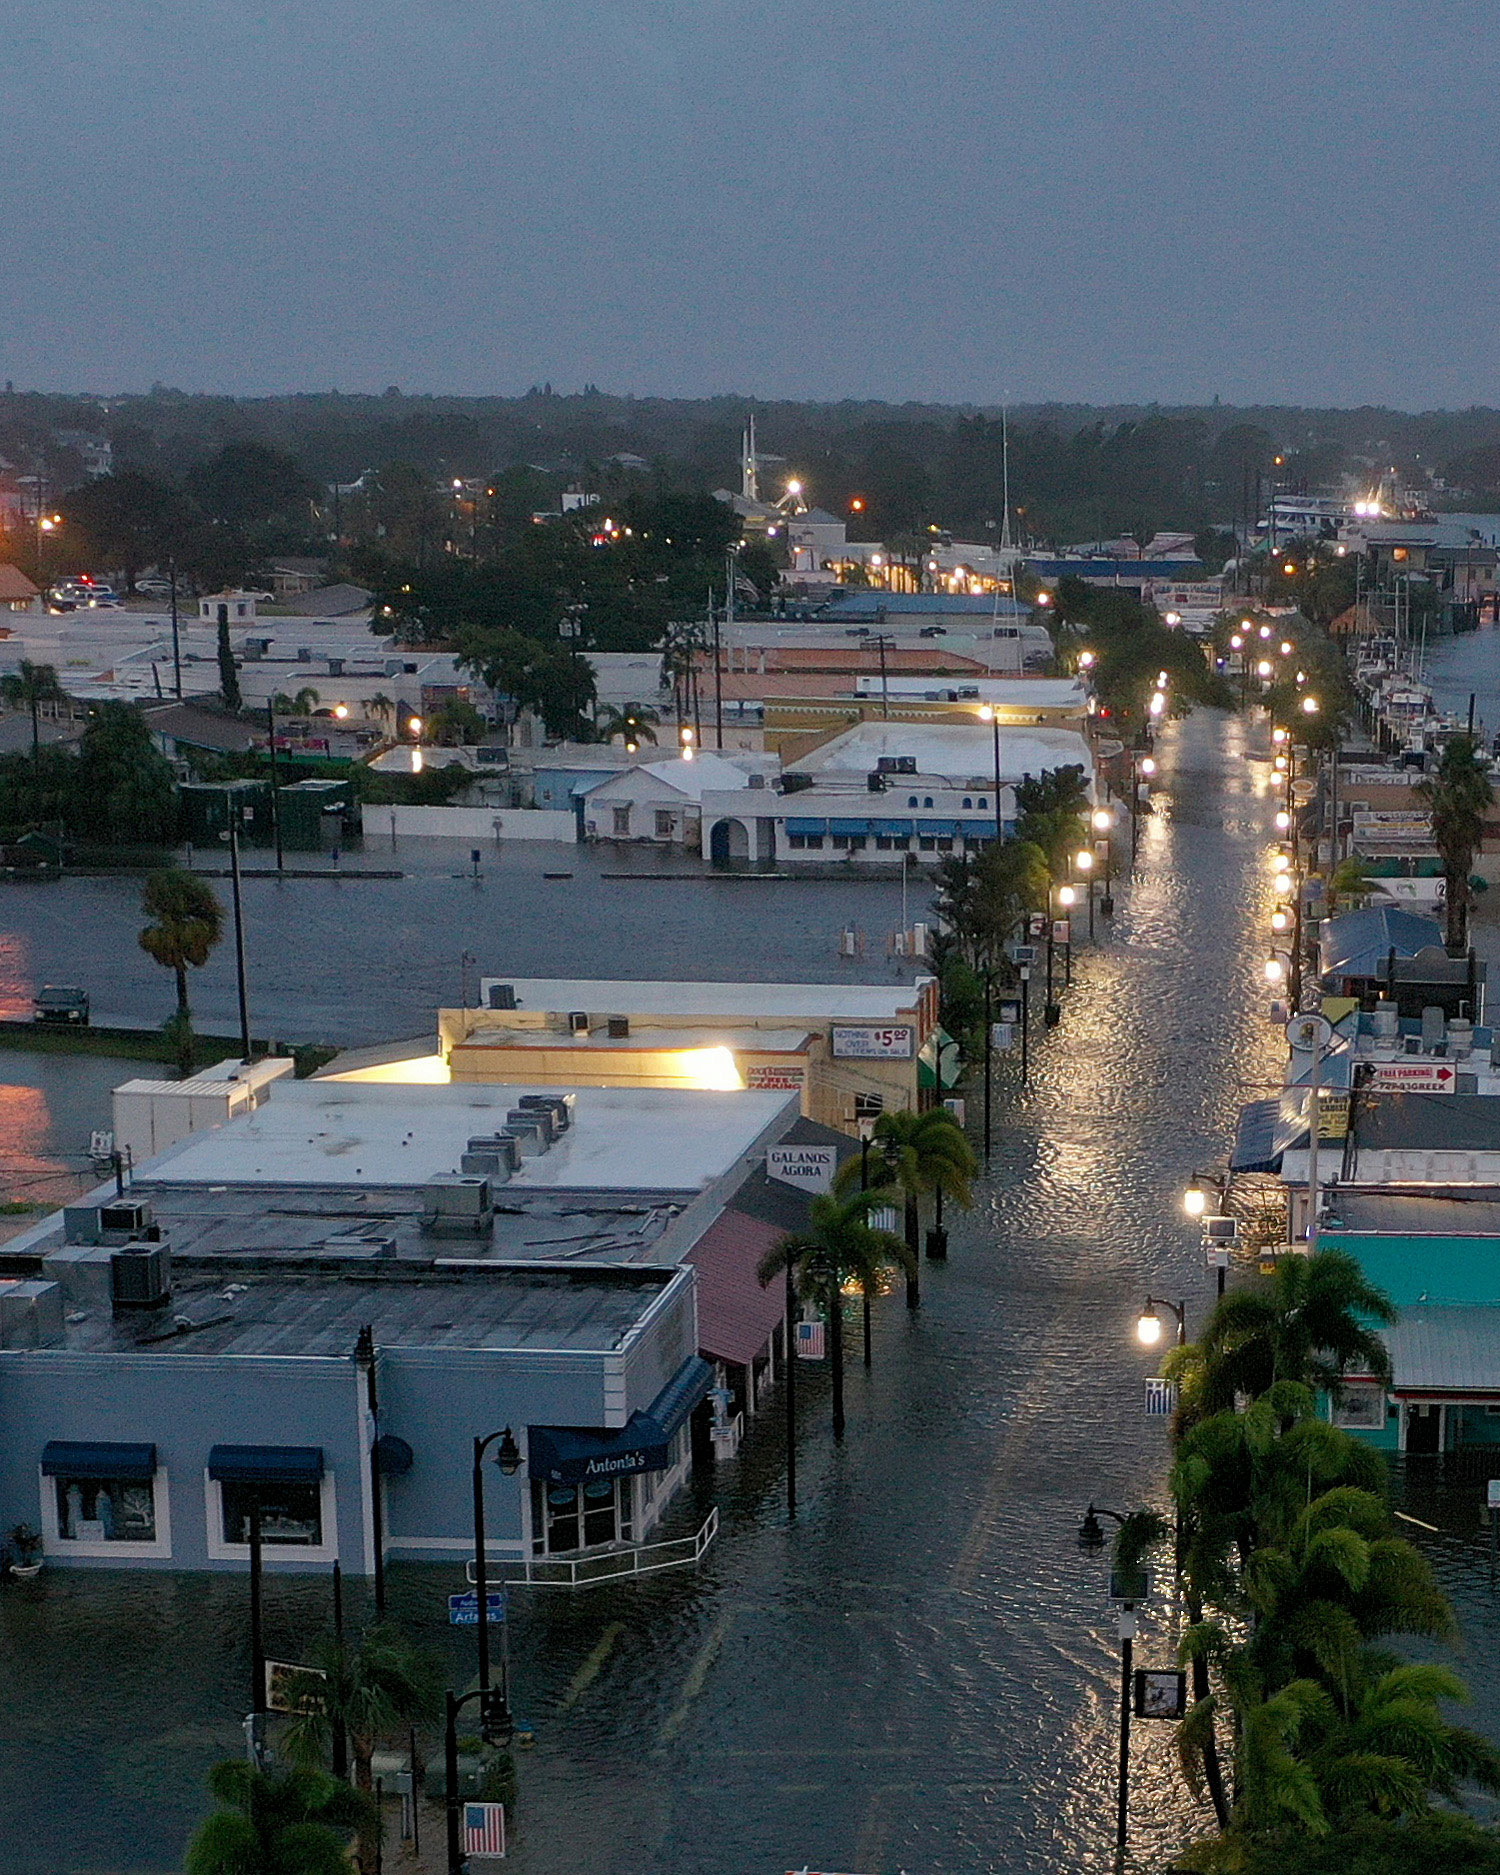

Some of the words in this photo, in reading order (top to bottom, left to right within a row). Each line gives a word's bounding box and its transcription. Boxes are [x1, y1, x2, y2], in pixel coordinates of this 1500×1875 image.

[834, 1030, 868, 1039] NOTHING
[846, 1040, 869, 1048] OVER
[1397, 1068, 1432, 1077] PARKING
[771, 1152, 830, 1164] GALANOS
[781, 1165, 821, 1176] AGORA
[585, 1451, 645, 1475] Antonia's
